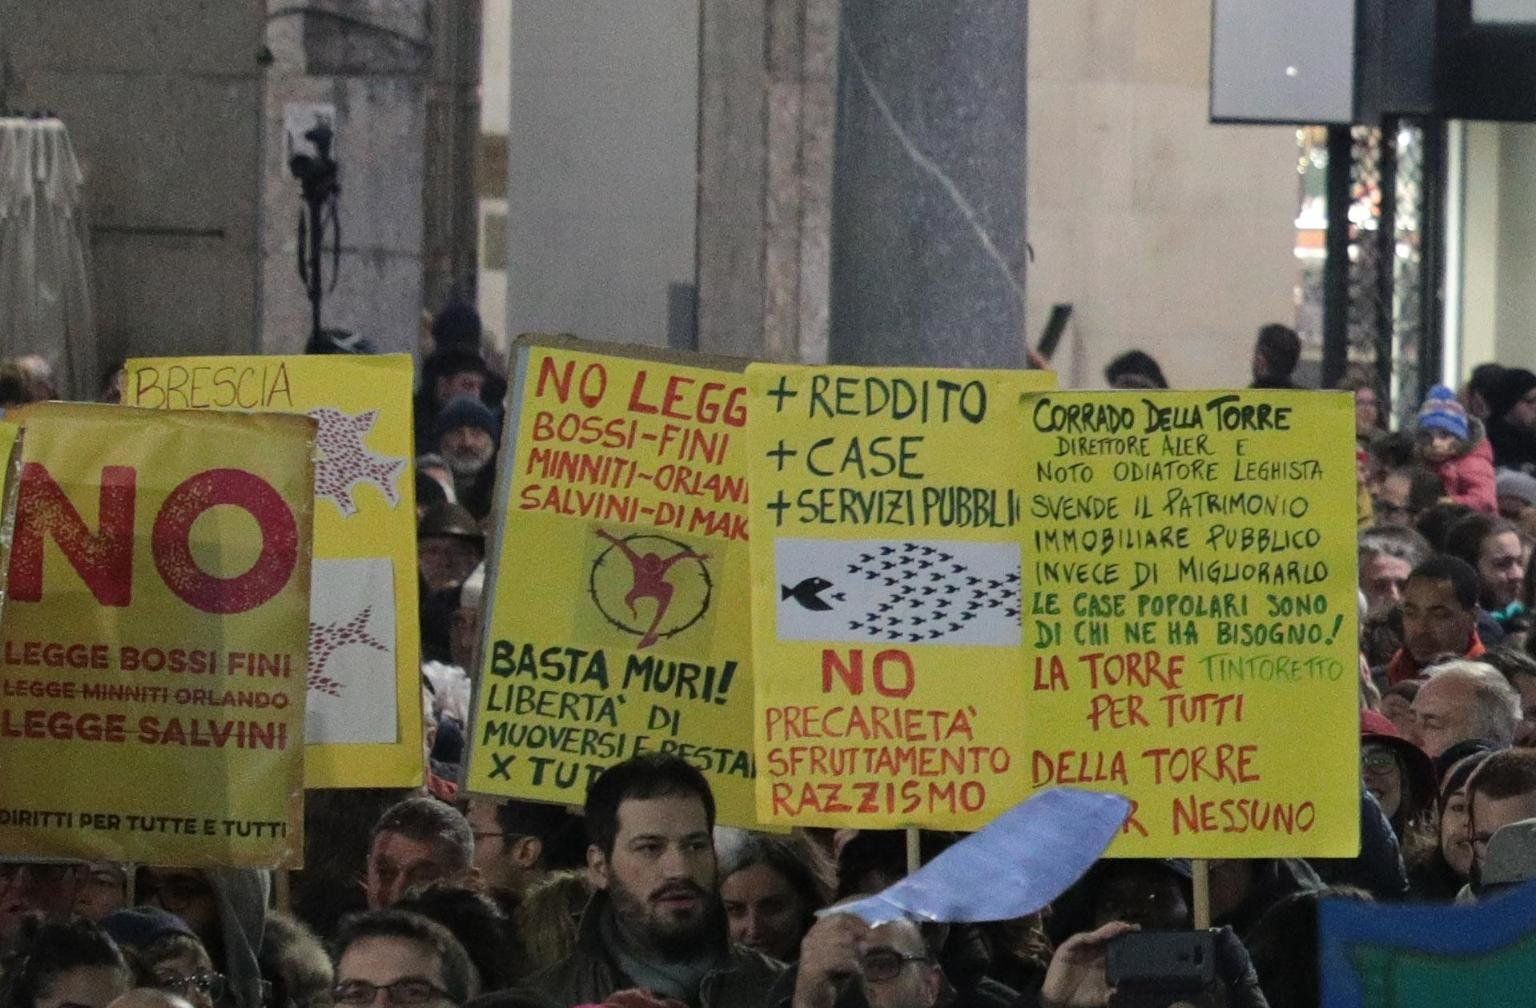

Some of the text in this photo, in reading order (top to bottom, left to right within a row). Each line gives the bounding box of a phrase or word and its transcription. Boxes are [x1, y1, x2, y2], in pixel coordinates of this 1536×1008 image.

[136, 361, 293, 409] BRESCIA
[535, 357, 607, 408] NO
[809, 375, 987, 424] REDDITO
[1033, 395, 1292, 434] CORRADO DELLA TORRE
[533, 411, 729, 465] BOSSI-FINI
[806, 435, 924, 479] CASE
[1054, 433, 1248, 457] DIRETTORE ALER E
[1037, 459, 1323, 483] NOTO ODIATORE LEGHISTA
[922, 486, 1020, 528] PUBBLI
[1031, 487, 1308, 521] SVENDE IL PATRIMONIO
[6, 462, 298, 615] NO
[1034, 524, 1321, 556] IMMOBILIARE PUBBLICO
[1036, 556, 1328, 591] INVECE DI MIGLIORARLO
[1032, 592, 1328, 618] LE CASE POPOLARI SONO
[1034, 614, 1343, 648] DI CHI NE HA BISOGNO!
[4, 640, 290, 678] LEGGE BOSSI FINI
[490, 640, 737, 704] BASTA MURI!
[822, 649, 915, 699] NO
[1033, 651, 1343, 691] LA TORRE TINTORETTO
[3, 679, 289, 710] LEGGE MINNITI ORLANDO
[1087, 693, 1243, 731] PER TUTTI
[1, 709, 287, 750] LEGGE SALVINI
[482, 720, 625, 758] MUOVERSI
[648, 704, 680, 737] DI
[488, 752, 516, 781] X
[767, 746, 1011, 778] SFRUTTAMENTO
[1031, 743, 1260, 788] DELLA TORRE
[772, 780, 986, 817] RAZZISMO
[1172, 794, 1315, 835] NESSUNO
[80, 812, 121, 831] PER
[126, 815, 196, 835] TUTTE
[204, 819, 215, 836] E
[222, 820, 287, 839] TUTTI
